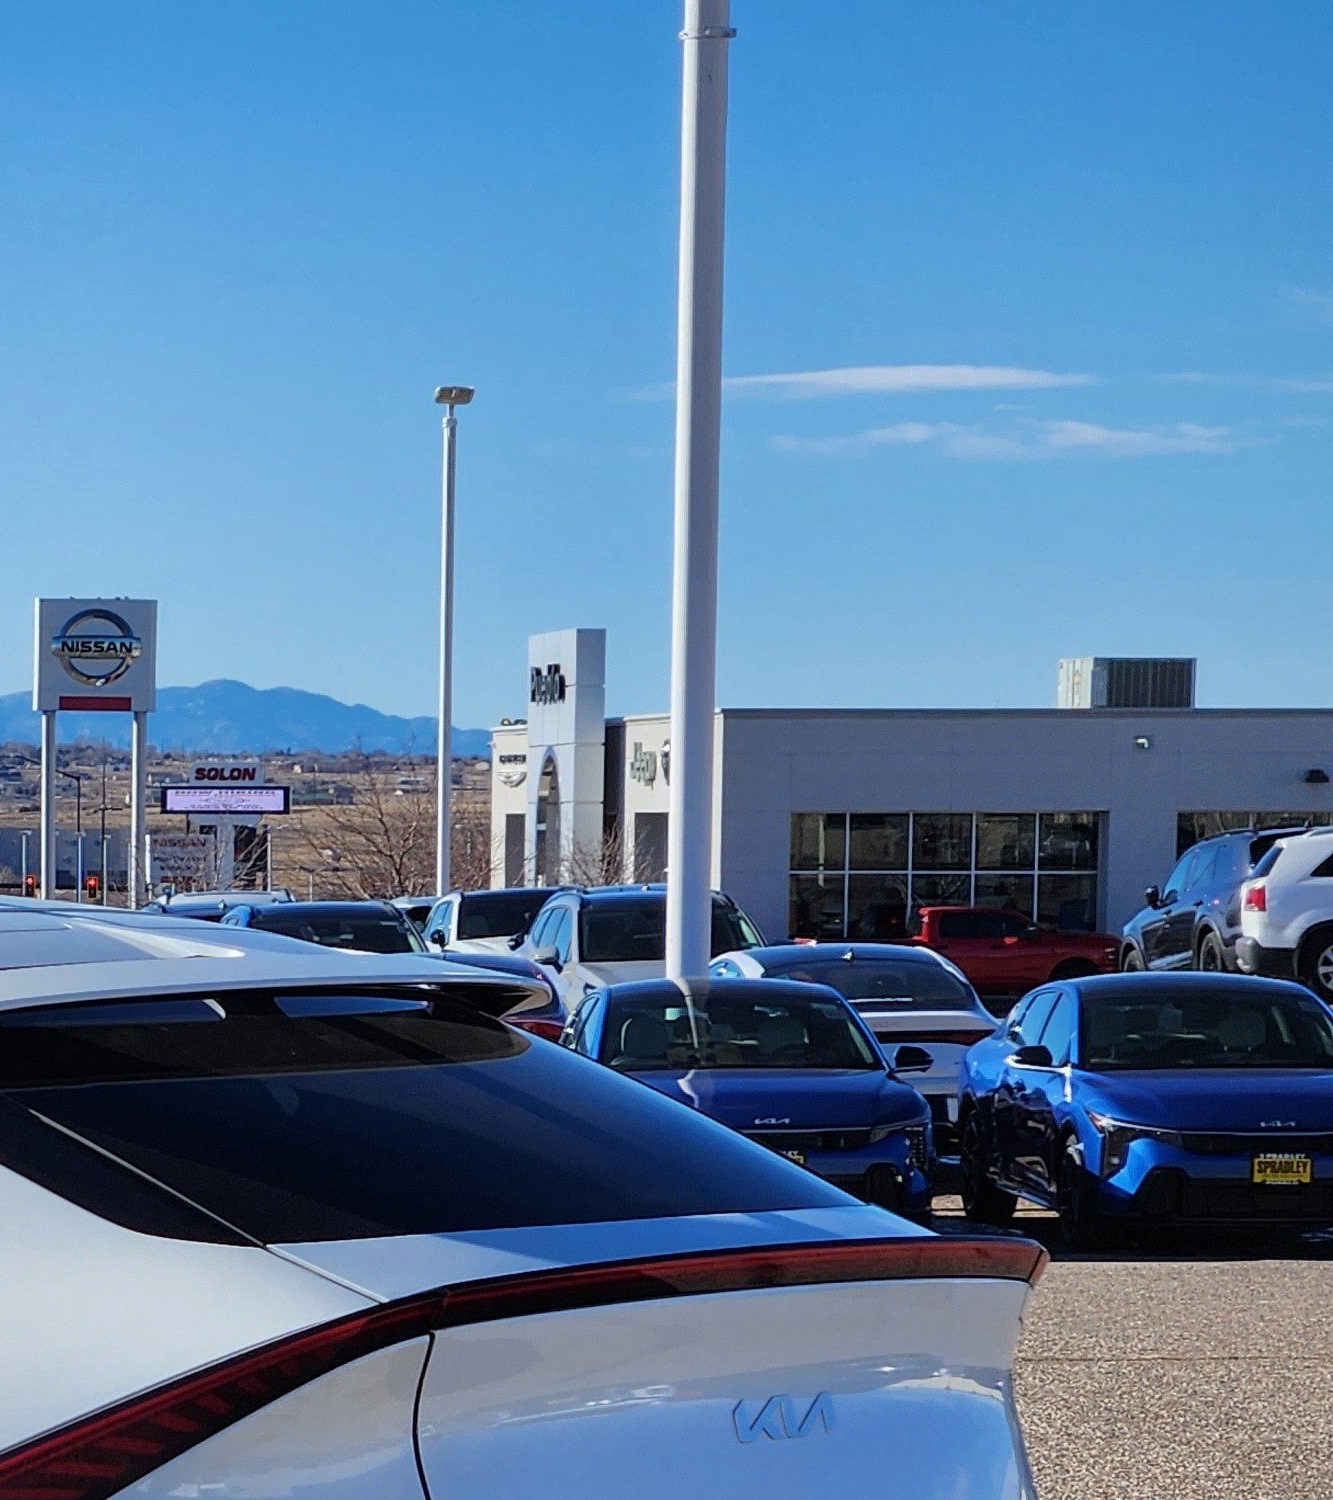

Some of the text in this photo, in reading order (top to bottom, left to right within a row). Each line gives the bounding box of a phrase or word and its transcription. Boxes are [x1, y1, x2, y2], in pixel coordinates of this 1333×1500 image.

[61, 640, 133, 654] NISSAN
[194, 767, 257, 781] SOLON
[1257, 1160, 1309, 1174] SPRADLEY
